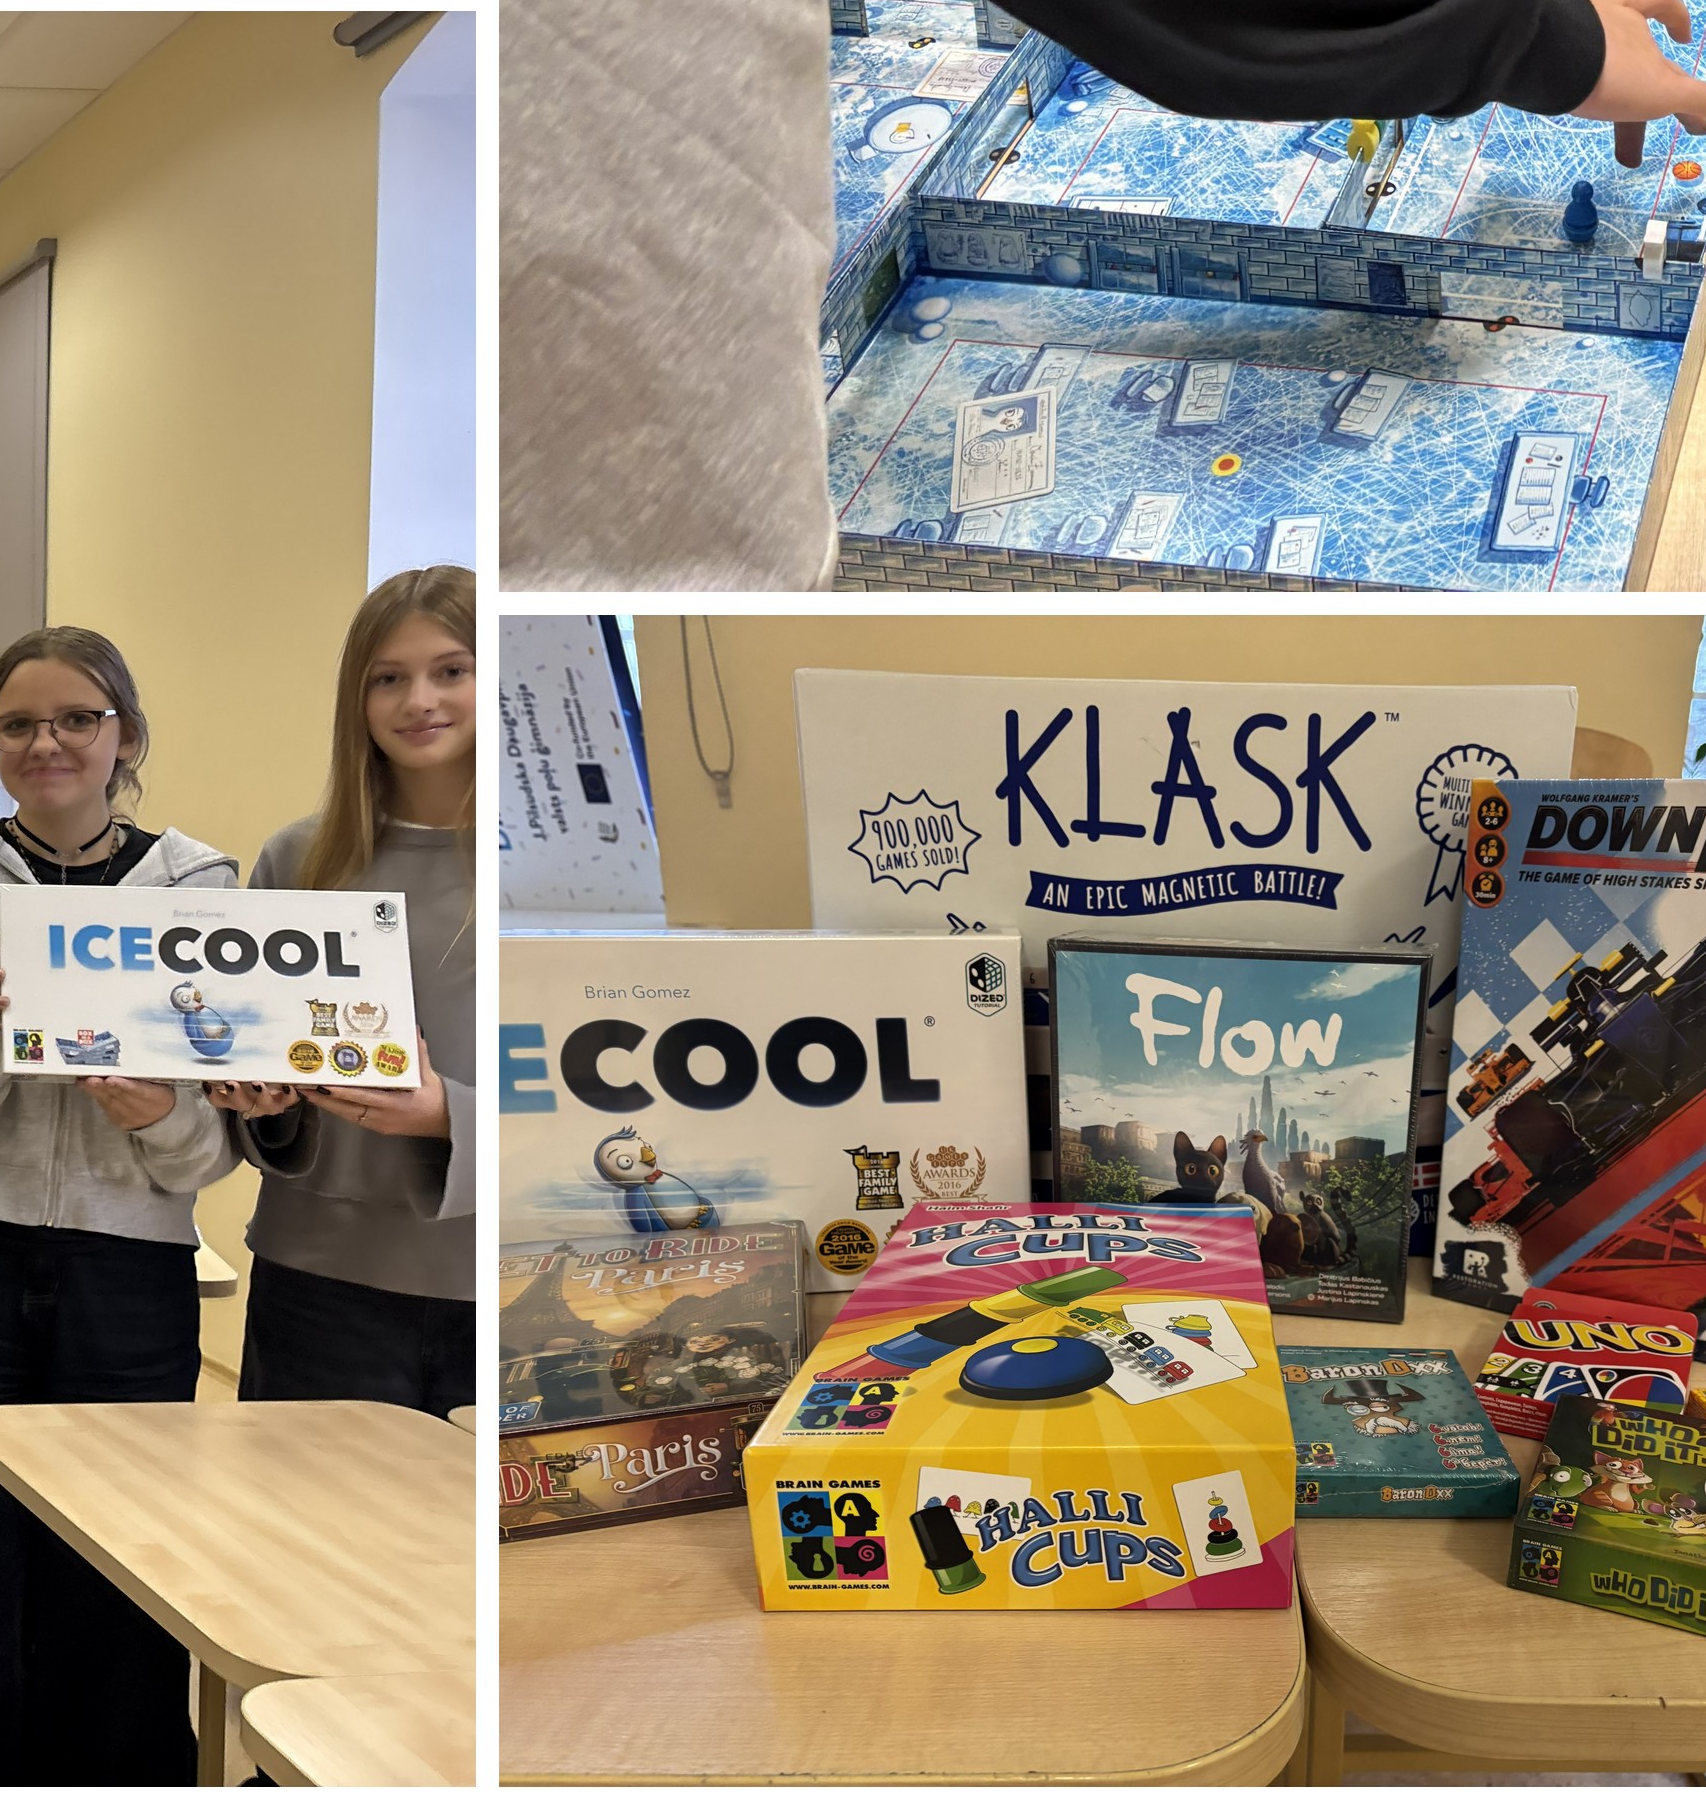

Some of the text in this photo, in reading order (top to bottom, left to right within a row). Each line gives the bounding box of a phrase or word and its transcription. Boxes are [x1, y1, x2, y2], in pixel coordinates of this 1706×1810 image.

[994, 704, 1377, 854] KLASK
[1541, 793, 1640, 804] WOLFGANG KRAMER'S
[870, 815, 955, 850] 900,000
[876, 843, 961, 871] GAMES SOLD!
[1043, 871, 1326, 909] AN EPIC MAGNETIC BATTLE!
[1518, 870, 1541, 884] THE
[1542, 871, 1580, 887] GAME
[1582, 873, 1602, 887] OF
[1604, 873, 1637, 889] HIGH
[1639, 875, 1692, 891] STAKES
[584, 985, 691, 999] Brian Gomez
[1125, 972, 1343, 1077] Flow
[859, 1178, 897, 1188] FAMILY
[864, 1187, 895, 1195] GAME
[923, 1168, 975, 1179] AWARDS
[645, 1233, 785, 1259] RIDE
[909, 1212, 1153, 1250] HALLI
[943, 1229, 1204, 1269] Cups
[572, 1260, 746, 1296] Paris
[1503, 1319, 1694, 1355] UNO
[582, 1433, 722, 1495] Paris
[775, 1480, 882, 1489] BRAIN GAMES
[973, 1490, 1149, 1554] HALLI
[1008, 1526, 1187, 1589] Cups
[788, 1583, 890, 1591] WWW.BRAIN-GAMES.COM
